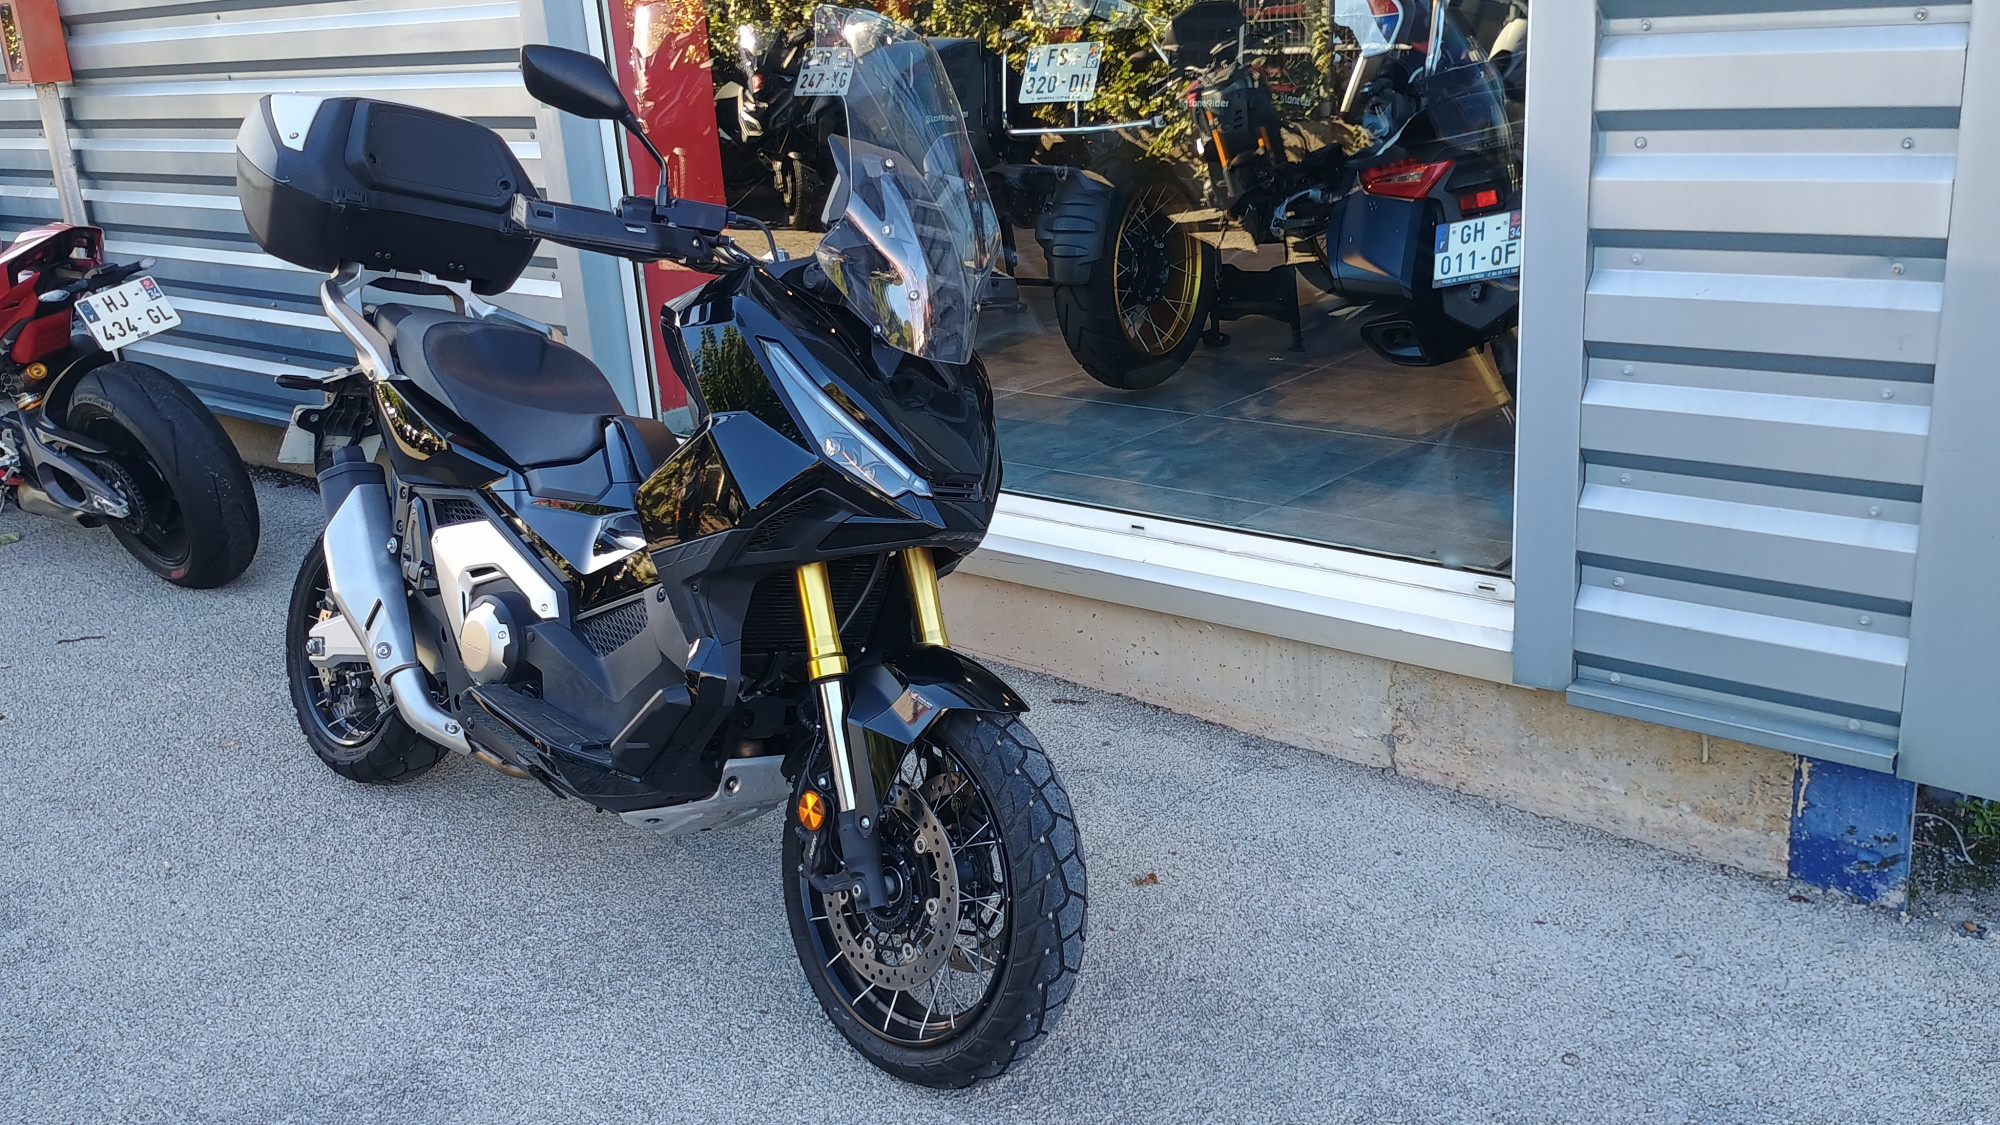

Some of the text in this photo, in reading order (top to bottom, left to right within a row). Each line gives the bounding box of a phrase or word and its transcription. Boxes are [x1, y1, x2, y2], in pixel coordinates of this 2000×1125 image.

[1460, 221, 1485, 244] GH
[1509, 227, 1520, 238] 34
[1441, 242, 1517, 275] 011-QF
[101, 290, 129, 313] HJ
[102, 305, 173, 341] 434-GL
